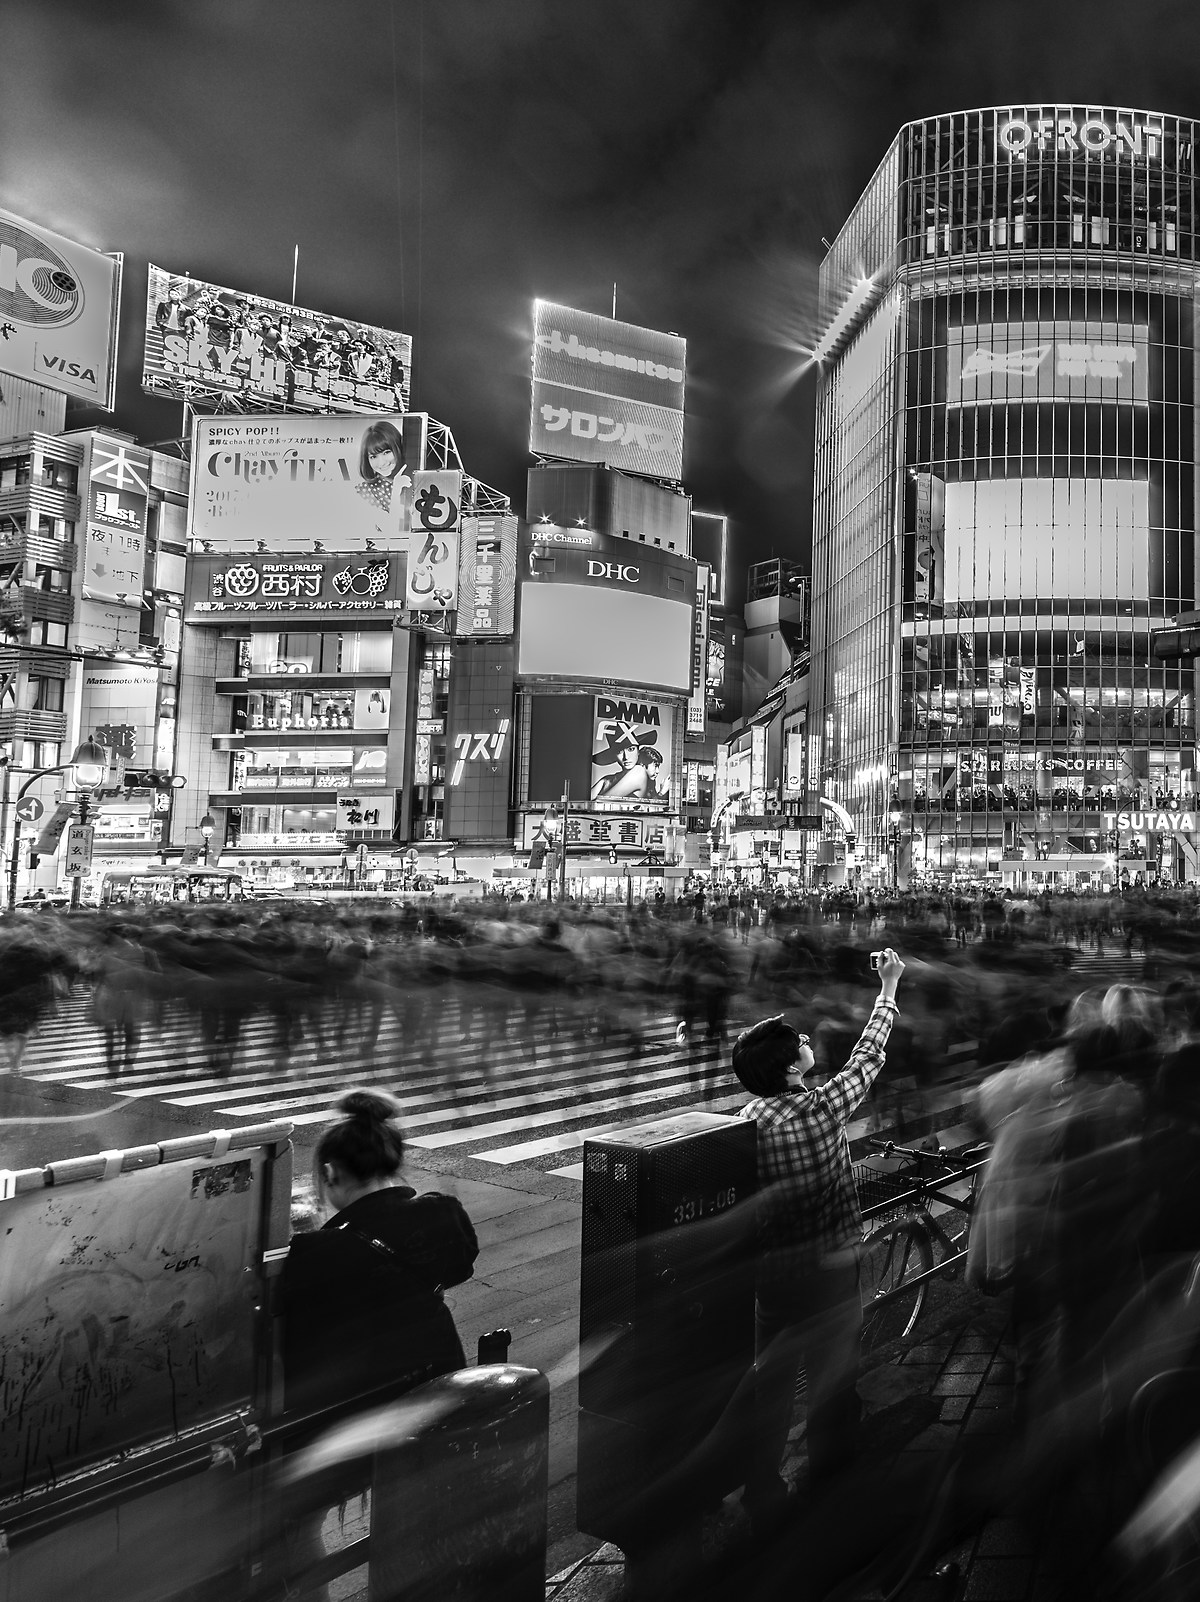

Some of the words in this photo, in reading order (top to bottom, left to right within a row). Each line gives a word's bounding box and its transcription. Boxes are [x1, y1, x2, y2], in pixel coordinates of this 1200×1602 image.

[43, 354, 96, 384] VISA
[163, 333, 286, 388] SKY-HI
[209, 428, 241, 436] SPICY
[246, 427, 280, 436] POP!!
[540, 404, 676, 456] サロンパス
[91, 447, 149, 489] 本
[531, 532, 553, 541] DHC
[553, 534, 592, 544] Channel
[587, 560, 640, 582] DHC
[262, 573, 323, 597] 西村
[86, 677, 132, 685] Matsumoto
[252, 714, 349, 732] Euphoria
[597, 698, 660, 726] DMM
[596, 721, 640, 745] FX
[960, 759, 1054, 772] STARBUCKS
[1065, 759, 1123, 771] COFFEE
[1104, 813, 1194, 830] TSUTAYA
[69, 830, 84, 873] 道玄坂
